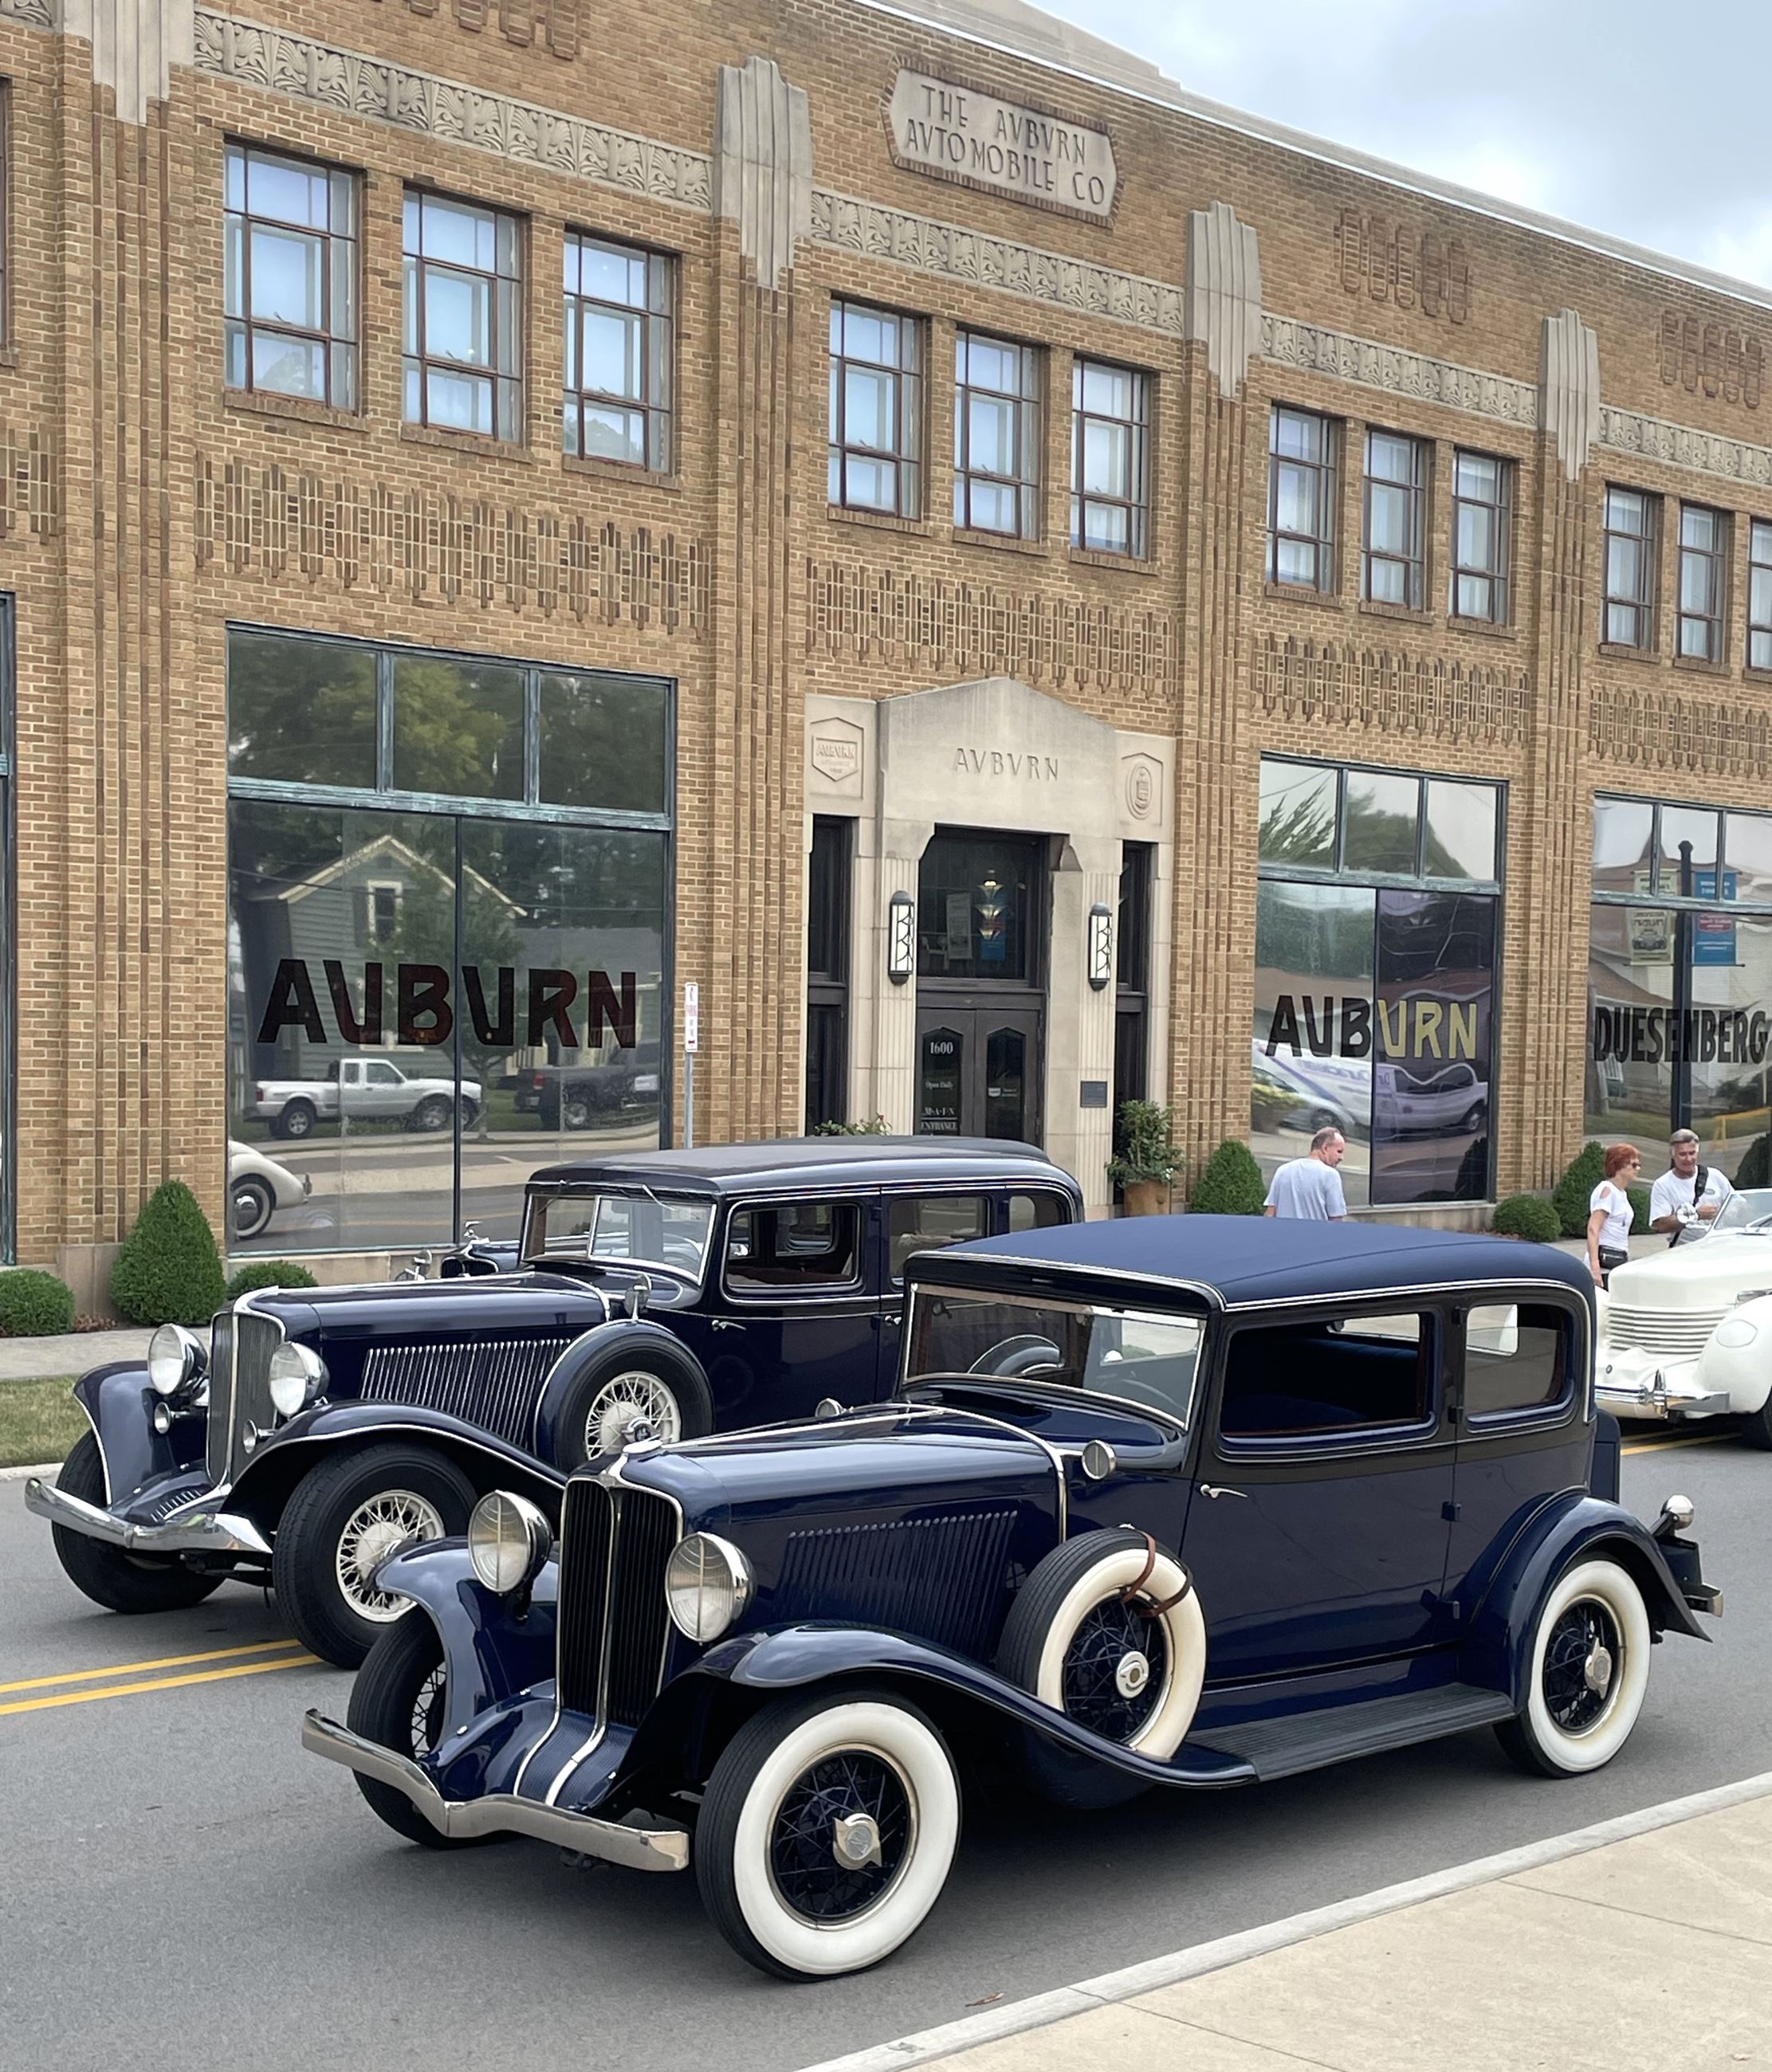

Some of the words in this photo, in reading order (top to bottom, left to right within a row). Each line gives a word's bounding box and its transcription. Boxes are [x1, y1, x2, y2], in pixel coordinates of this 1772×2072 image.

[921, 84, 968, 128] THE
[1072, 171, 1105, 205] CO
[955, 747, 1059, 782] AVBVRN
[256, 958, 637, 1049] AUBURN
[929, 1041, 954, 1055] 1600
[1264, 995, 1478, 1060] AUBURN
[1594, 1006, 1768, 1065] DUESENBERG
